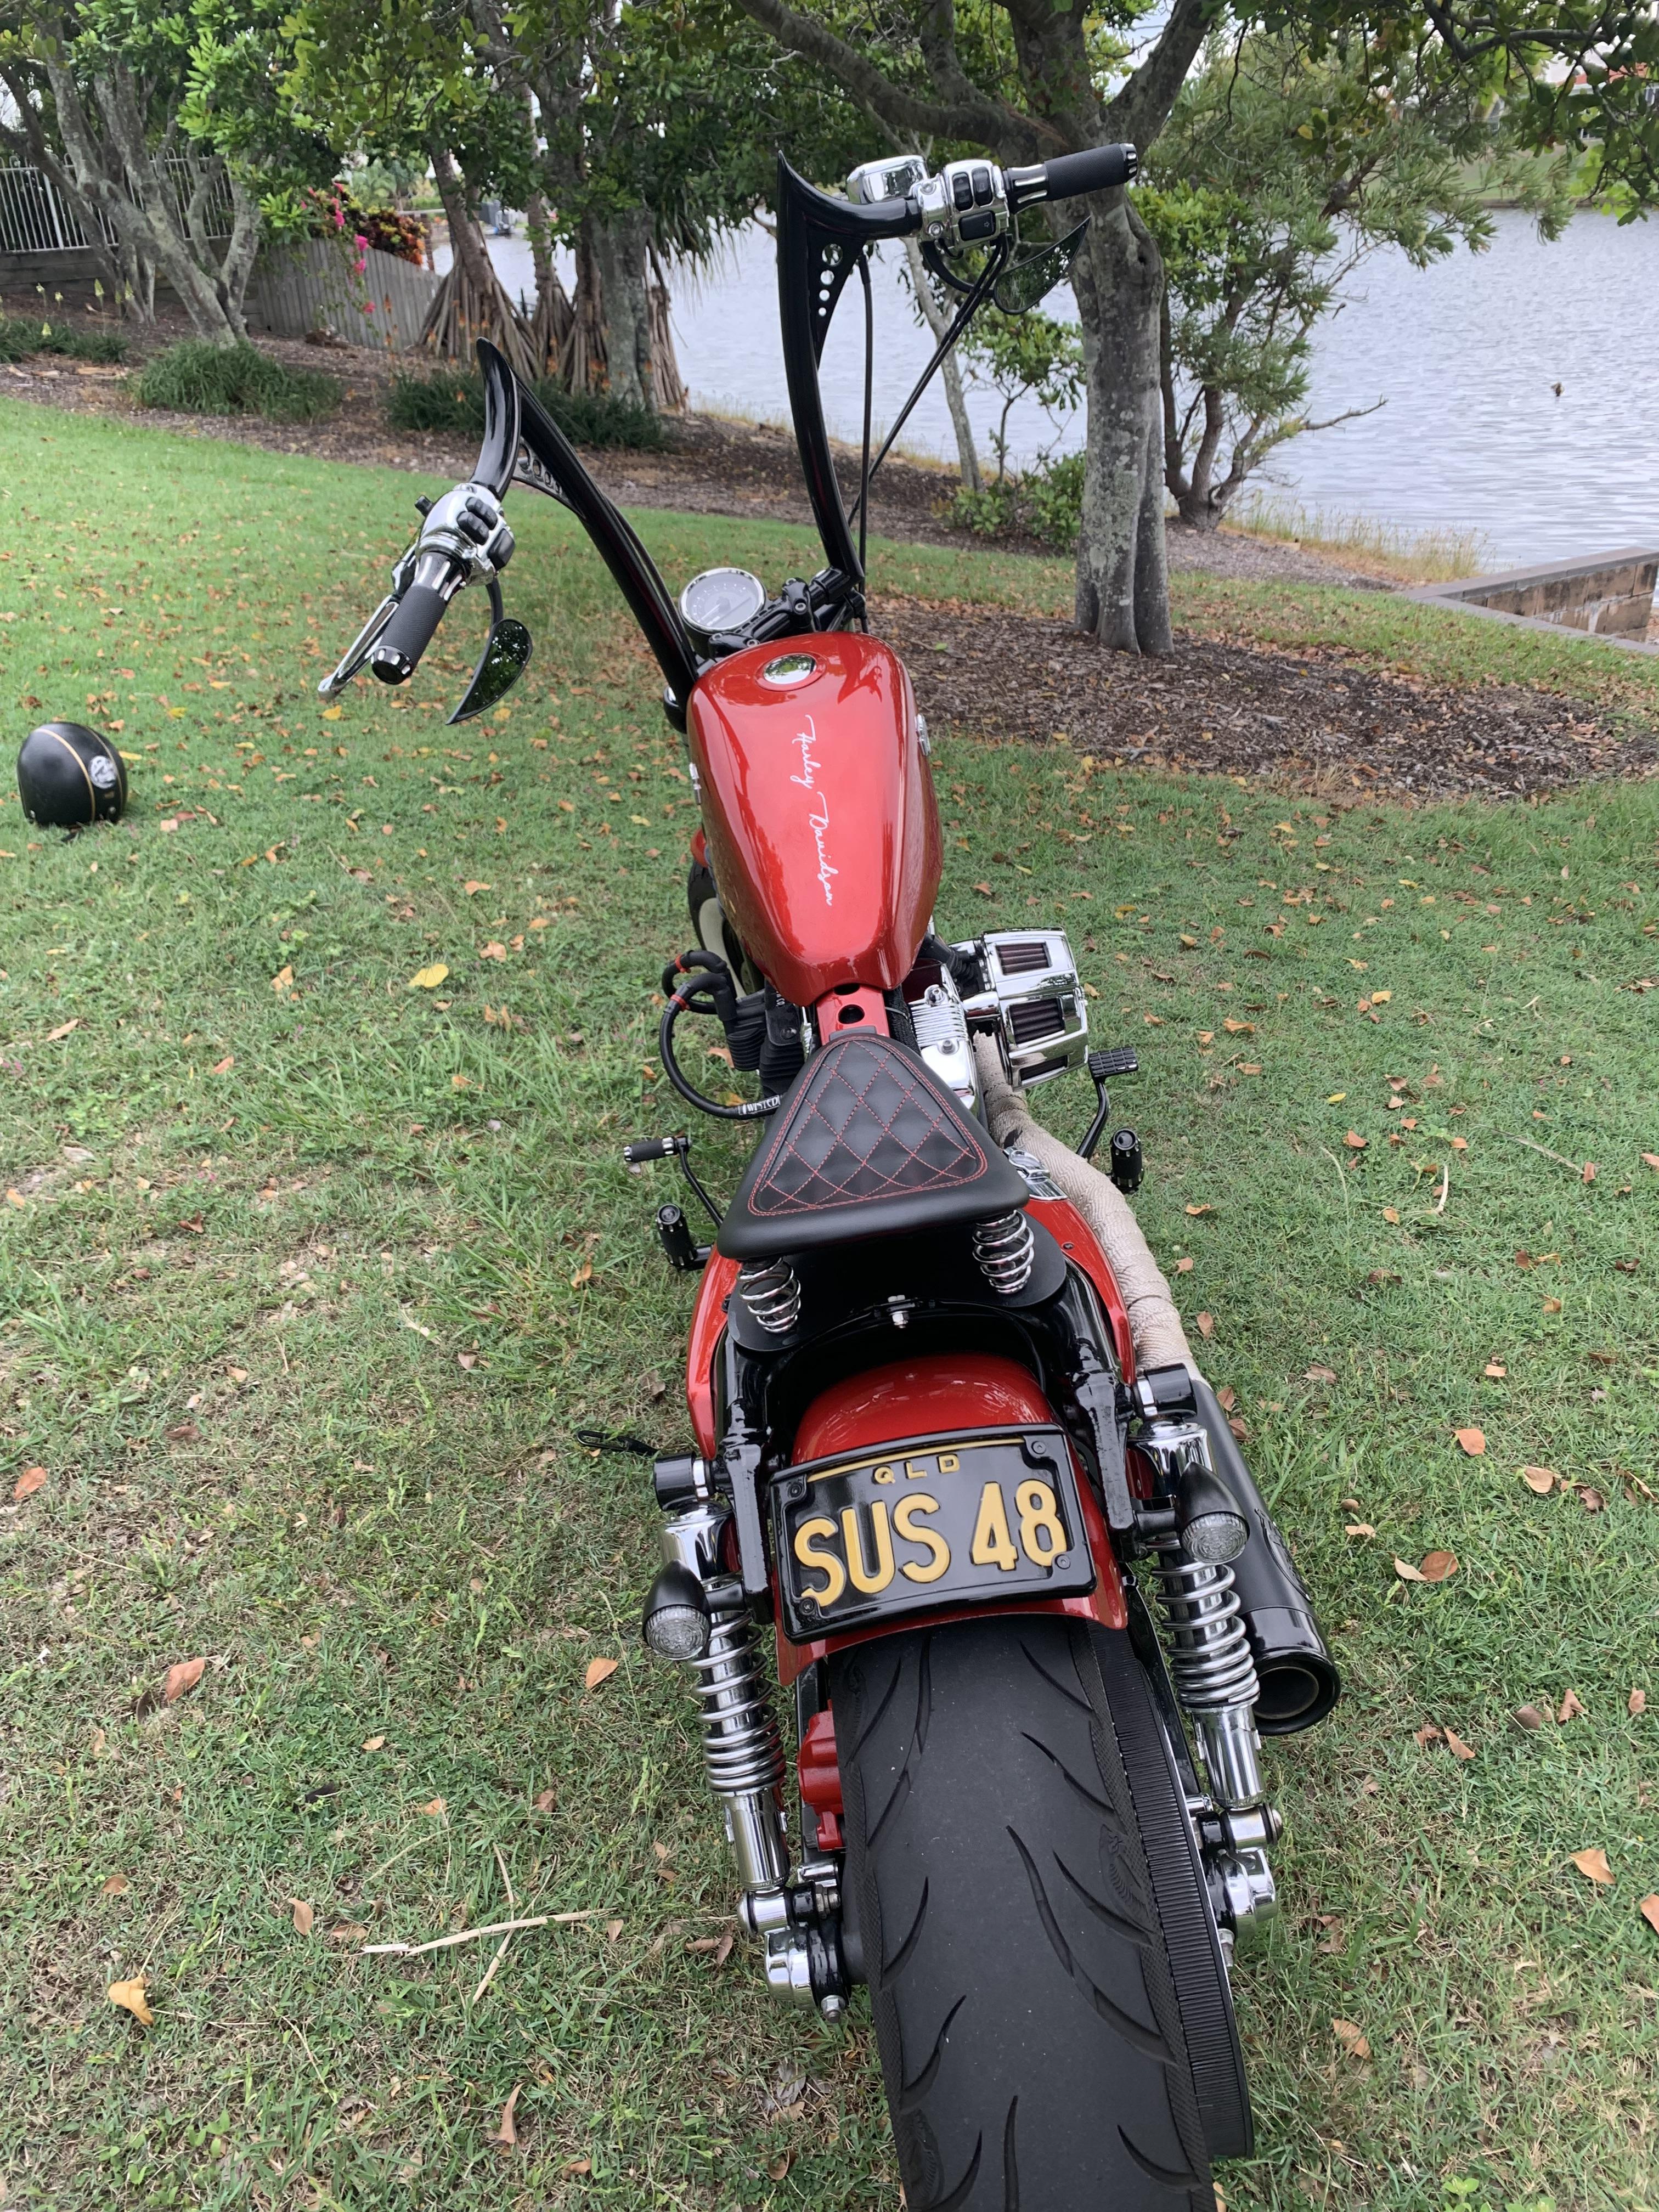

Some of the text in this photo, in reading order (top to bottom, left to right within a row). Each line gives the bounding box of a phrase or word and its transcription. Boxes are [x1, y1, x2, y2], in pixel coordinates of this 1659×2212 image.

[789, 714, 839, 906] Harley Davidson
[794, 1480, 1067, 1607] SUS 48
